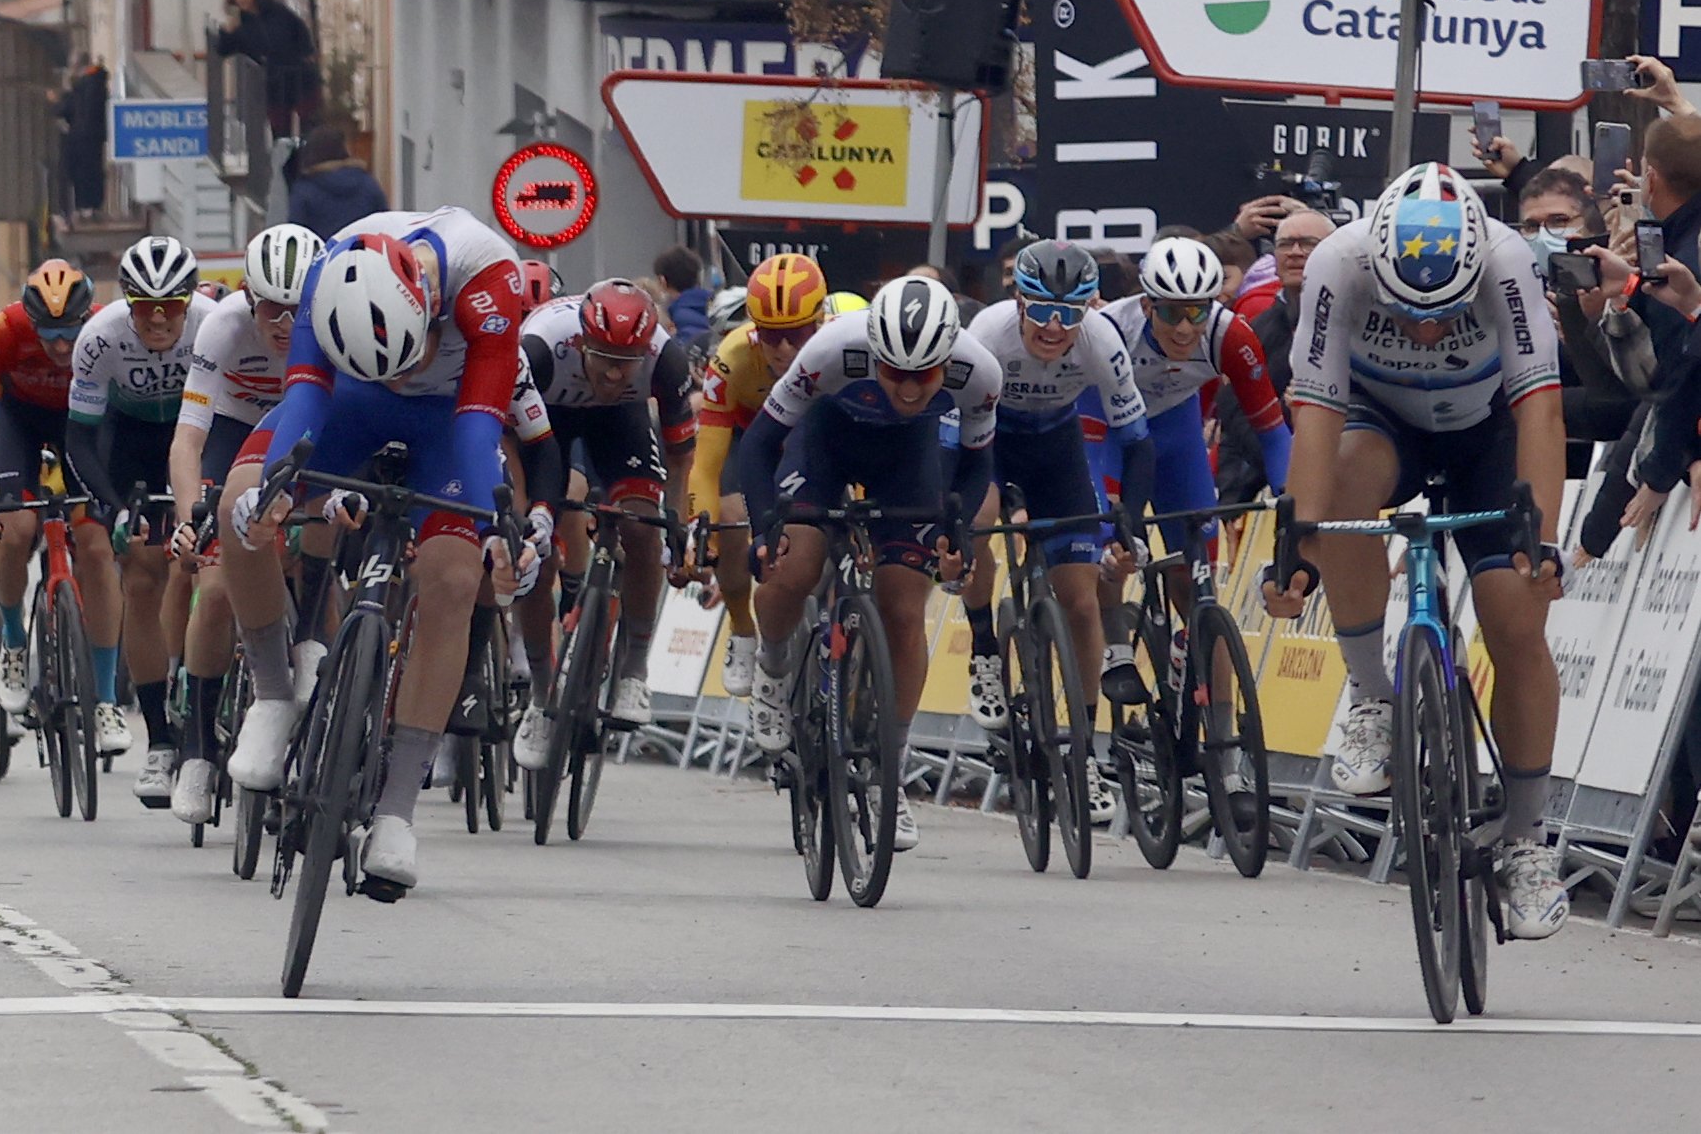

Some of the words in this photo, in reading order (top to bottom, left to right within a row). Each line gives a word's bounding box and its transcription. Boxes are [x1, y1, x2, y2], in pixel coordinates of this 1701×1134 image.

[122, 110, 208, 129] MOBLES
[1054, 48, 1157, 254] BIK
[1273, 124, 1370, 159] GOBIK
[1307, 284, 1335, 369] MERIDA
[1499, 277, 1535, 355] MERIDA
